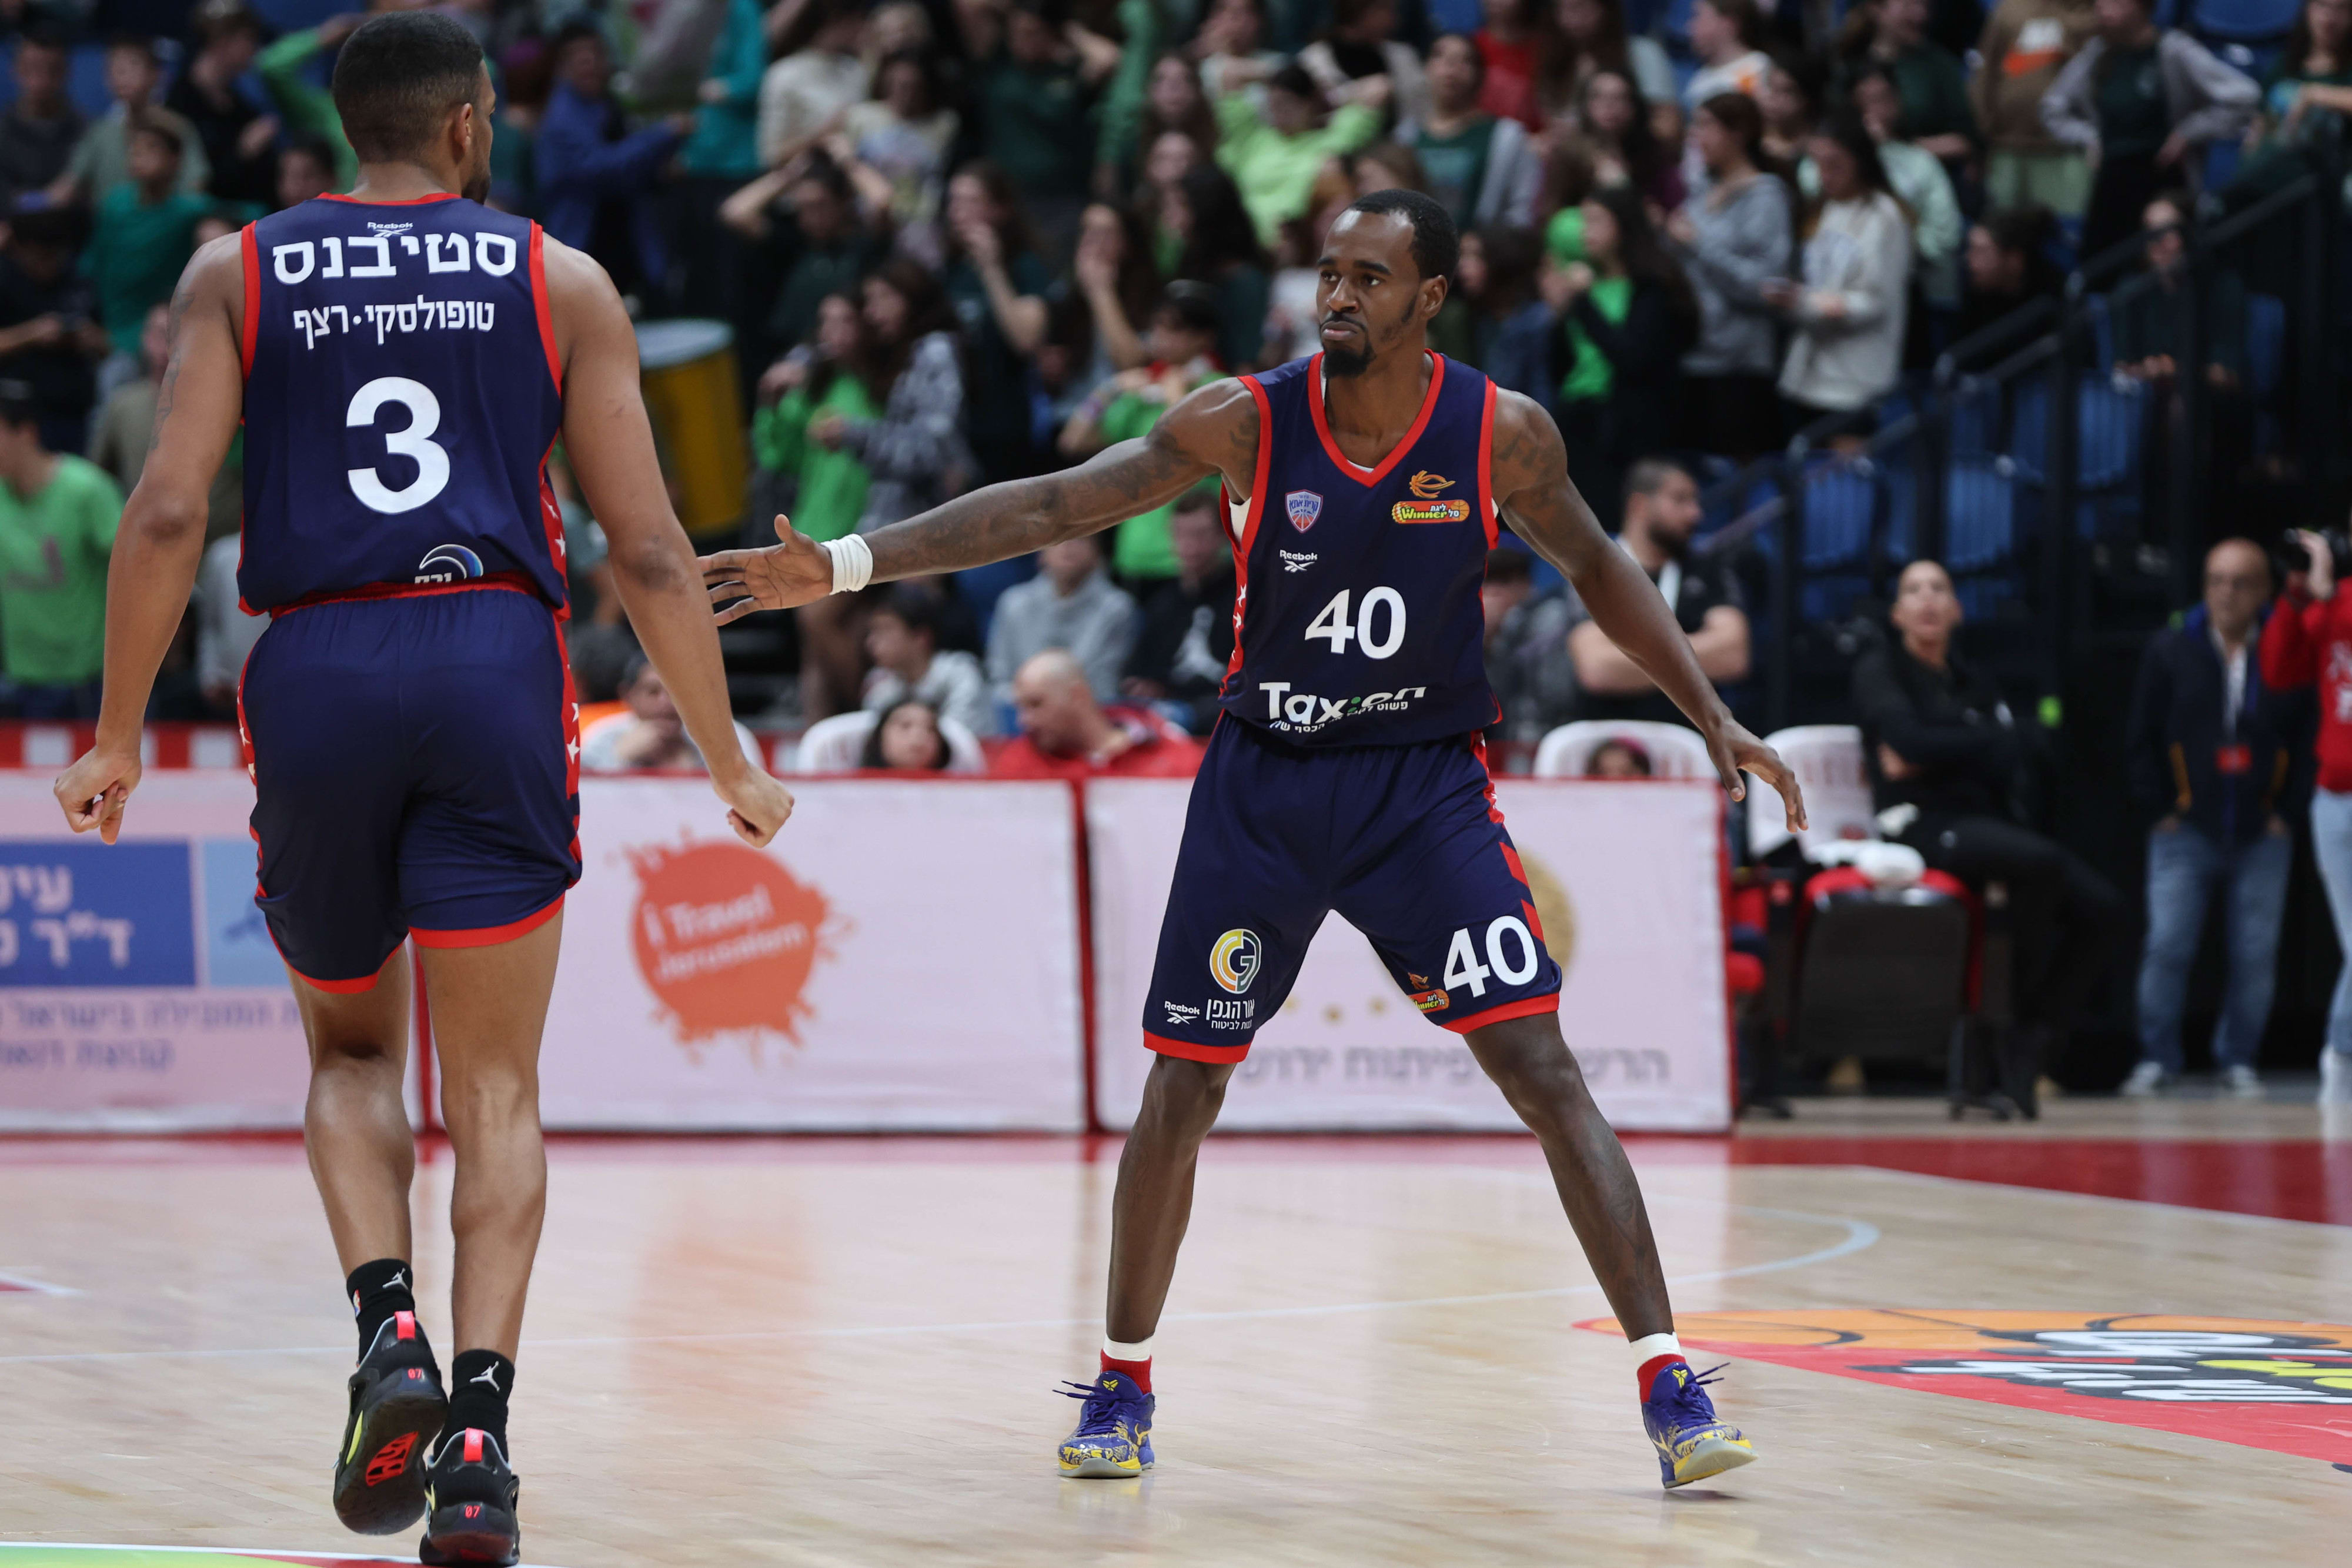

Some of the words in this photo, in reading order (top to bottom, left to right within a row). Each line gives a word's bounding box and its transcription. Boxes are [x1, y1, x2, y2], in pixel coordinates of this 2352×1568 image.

[367, 222, 413, 230] Reebok
[272, 232, 517, 285] סטיבנס
[346, 376, 450, 516] 3
[1401, 507, 1448, 519] Winner
[1448, 509, 1460, 517] סל
[1429, 503, 1446, 512] ליגת
[1279, 549, 1318, 560] Reebok
[1305, 586, 1406, 659] 40
[1377, 701, 1408, 711] פשוט
[664, 883, 775, 941] Travel
[1443, 915, 1538, 998] 40
[1164, 1001, 1200, 1015] Reebok
[1206, 999, 1241, 1020] הגפן
[1211, 1020, 1240, 1029] לביטוח
[1344, 1047, 1474, 1083] פיתוח
[407, 1369, 422, 1379] 07
[465, 1506, 480, 1518] 07
